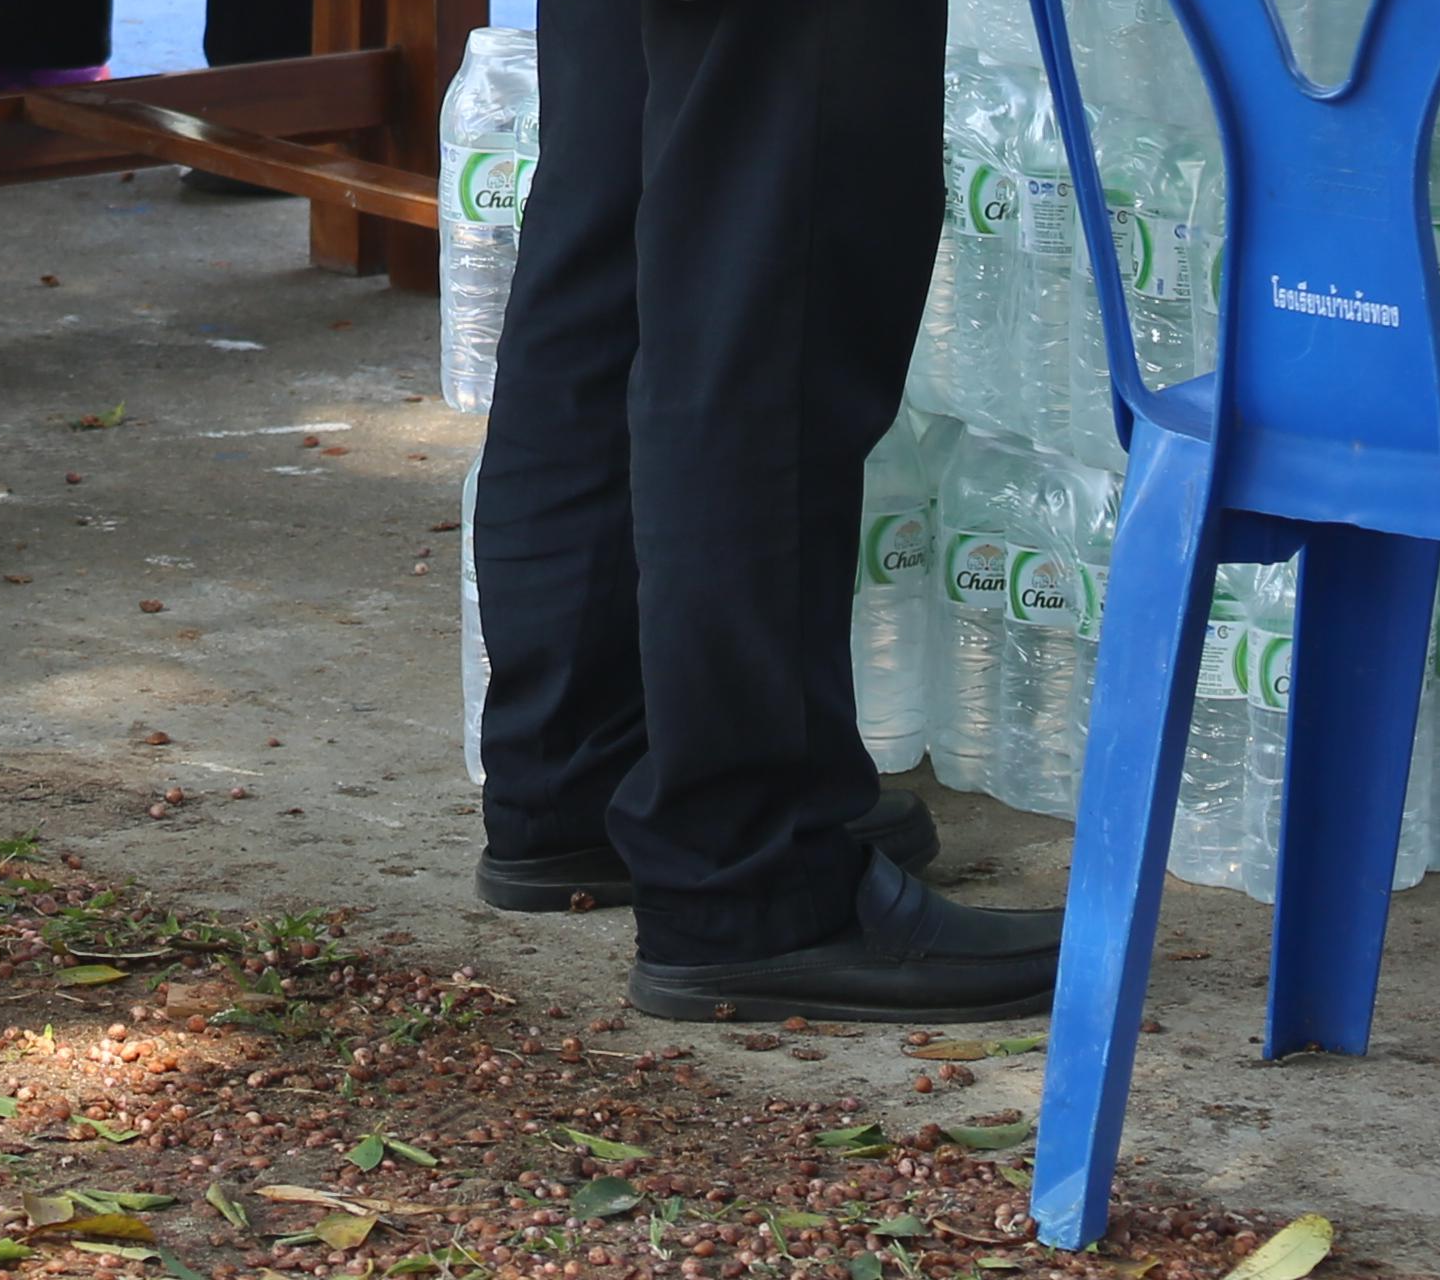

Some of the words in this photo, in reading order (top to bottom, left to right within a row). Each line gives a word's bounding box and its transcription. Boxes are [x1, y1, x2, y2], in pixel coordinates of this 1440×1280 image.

[475, 189, 514, 209] Cha
[1270, 274, 1400, 328] โรงเรียนบ้านวังทอง
[956, 570, 1007, 592] Chan
